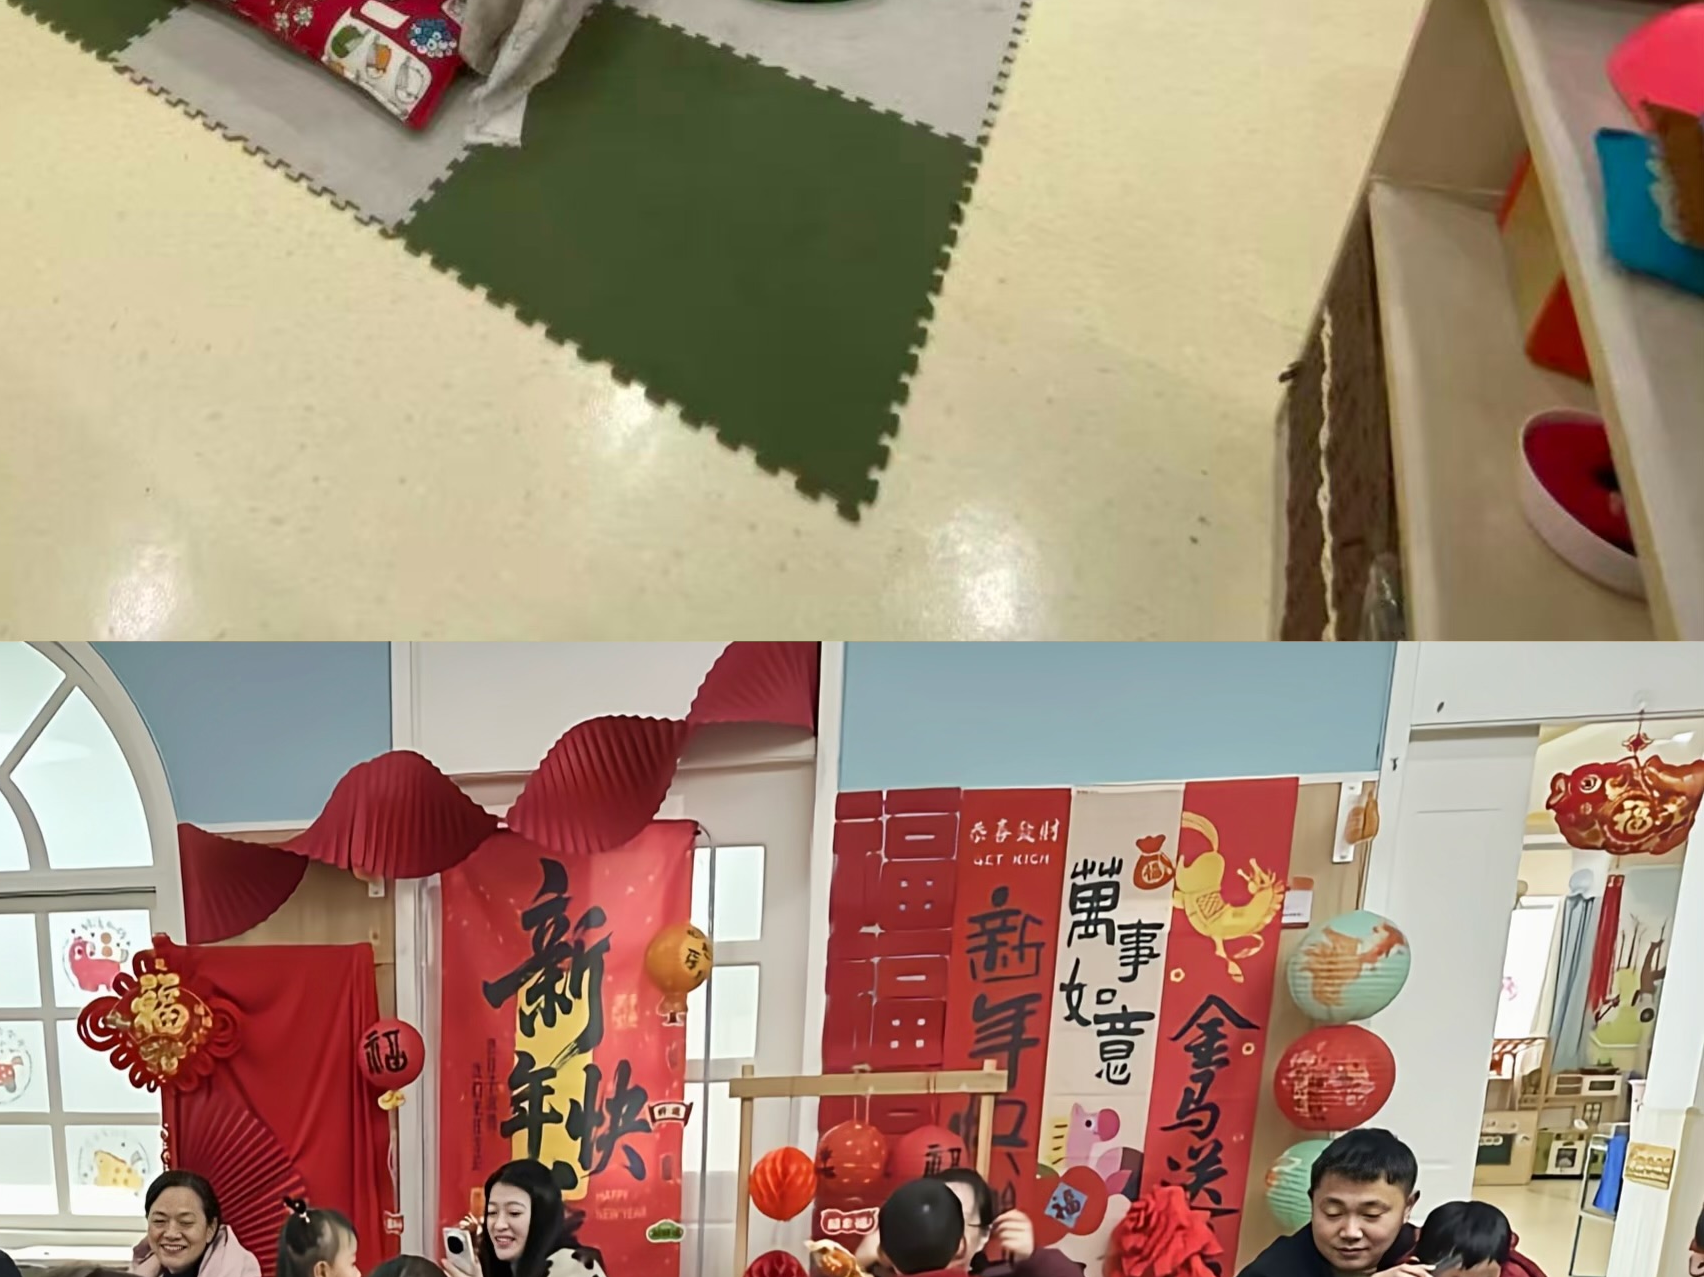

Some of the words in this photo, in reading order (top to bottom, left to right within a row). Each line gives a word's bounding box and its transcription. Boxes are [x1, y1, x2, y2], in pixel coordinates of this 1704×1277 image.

[482, 857, 653, 1232] 新年快
[1059, 856, 1164, 1085] 萬事如意
